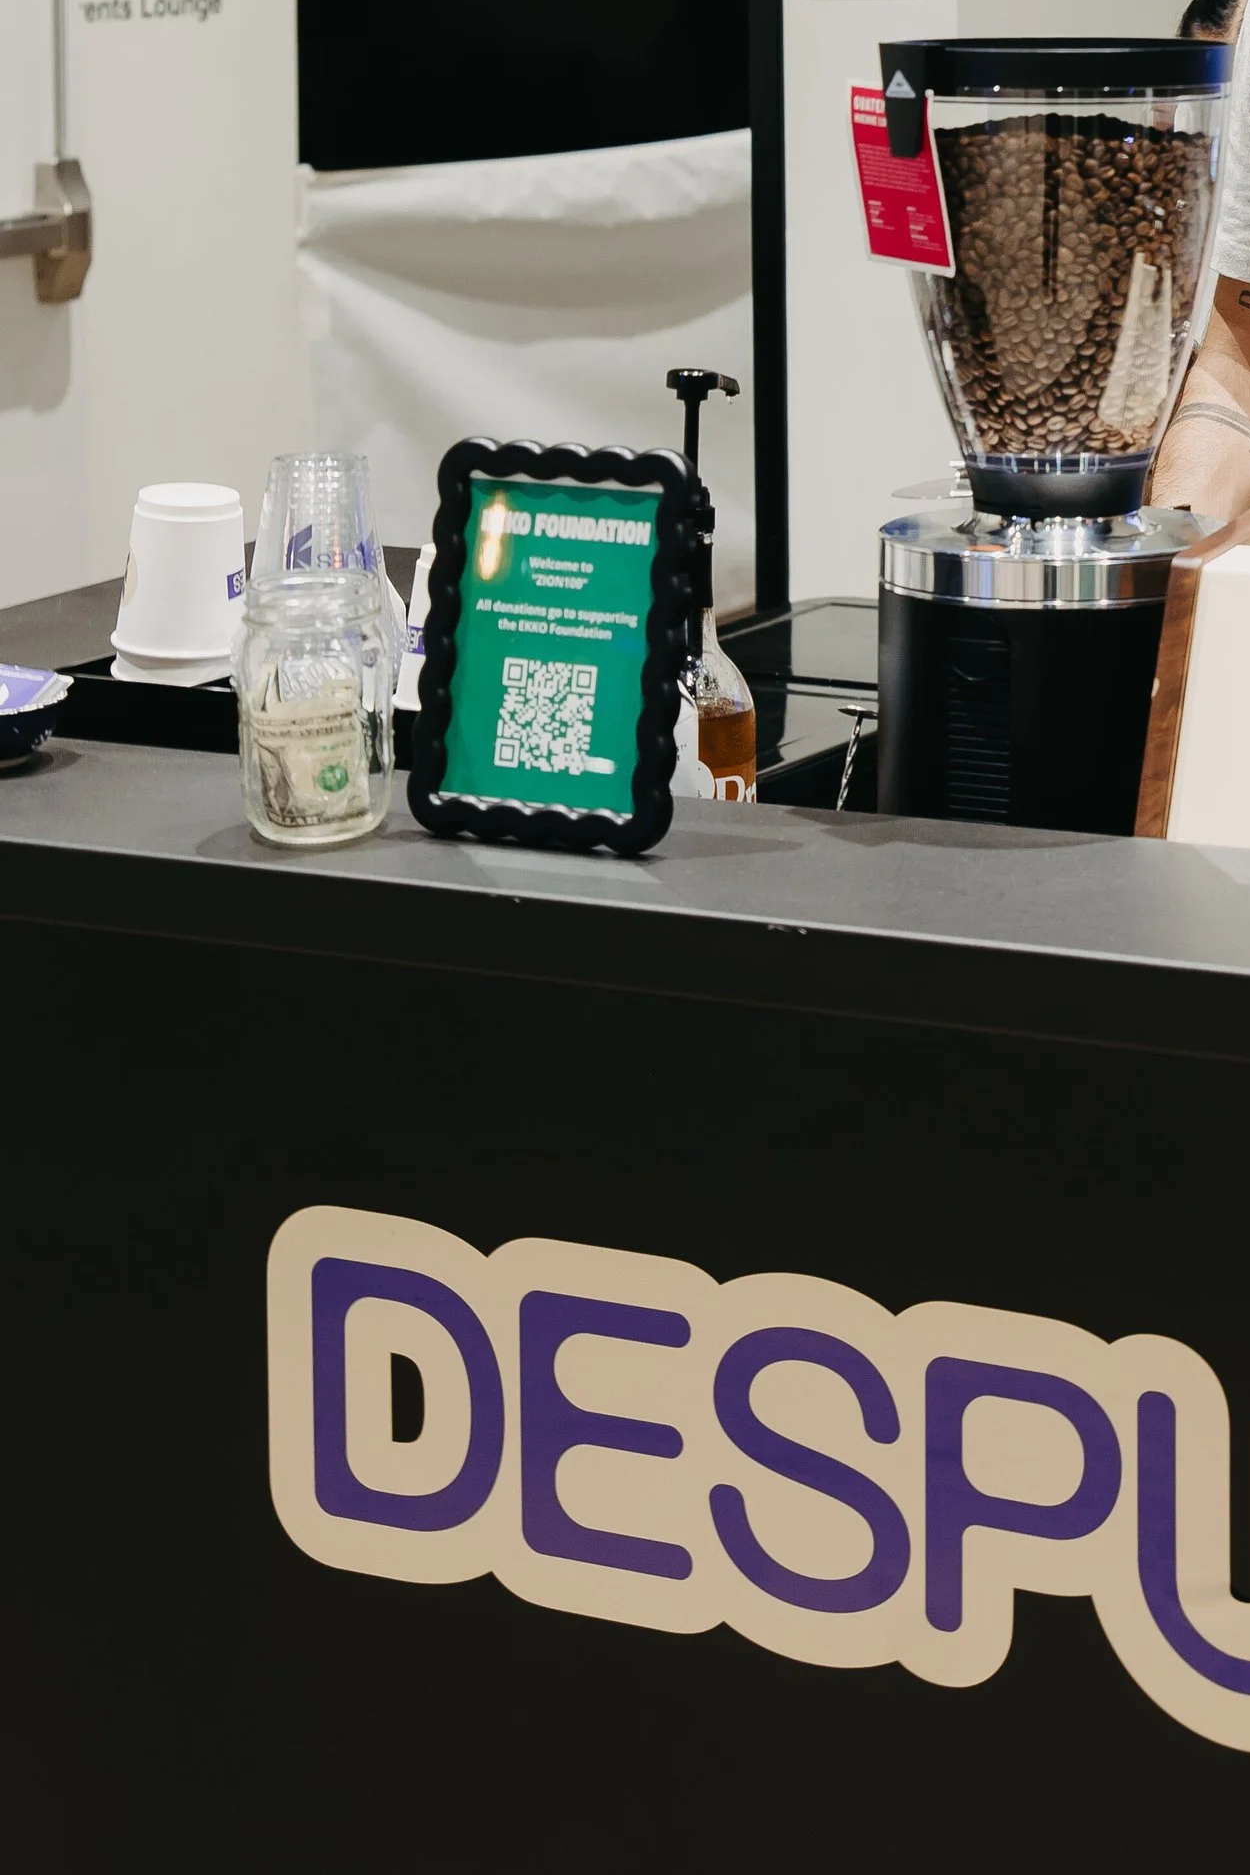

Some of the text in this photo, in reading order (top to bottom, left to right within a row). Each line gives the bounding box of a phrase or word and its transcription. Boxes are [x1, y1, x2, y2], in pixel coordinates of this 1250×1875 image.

[481, 508, 651, 546] EKO FOUNDATION
[529, 556, 594, 574] Welcome to
[476, 599, 638, 628] All donations go to supporting
[498, 618, 517, 631] the
[549, 623, 613, 640] Foundation
